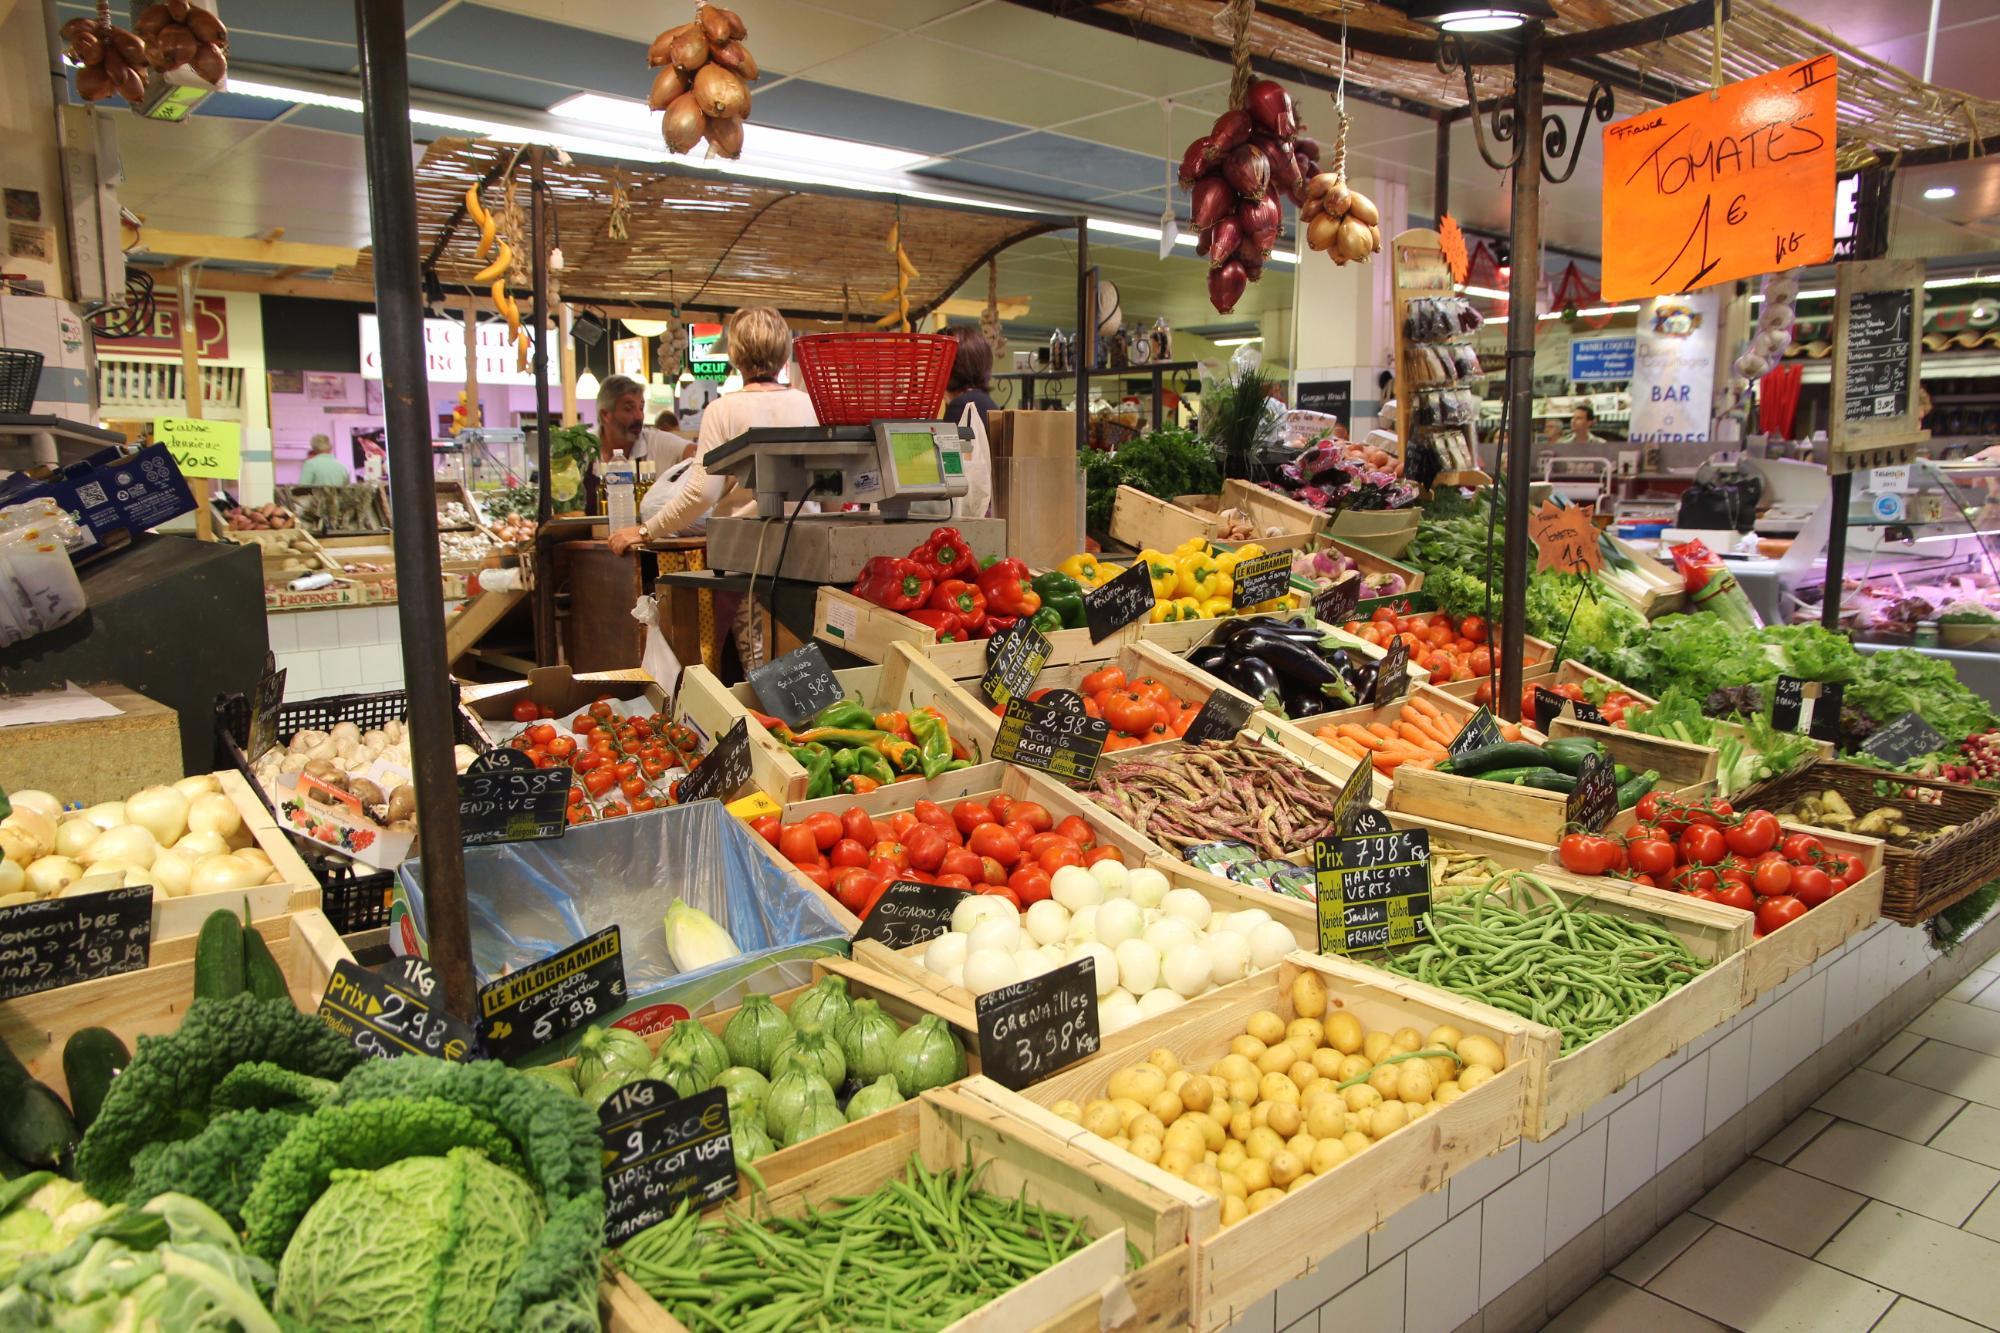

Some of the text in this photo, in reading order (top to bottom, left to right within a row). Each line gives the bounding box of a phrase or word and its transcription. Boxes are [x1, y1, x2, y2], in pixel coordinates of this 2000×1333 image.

[1626, 113, 1824, 194] TOMATES
[1651, 194, 1748, 292] 1 €
[1651, 385, 1690, 402] BAR
[279, 592, 338, 607] PROVENCE
[983, 673, 1001, 695] Prix
[1008, 700, 1032, 721] Prix
[1040, 710, 1087, 735] 2,98
[1019, 739, 1052, 756] ROMA
[475, 752, 510, 773] 1Kg
[1316, 841, 1344, 868] Prix
[1410, 845, 1430, 867] Kg
[1318, 882, 1343, 902] Produit
[1347, 882, 1392, 900] VERTS
[1320, 911, 1343, 929] Variété
[1388, 901, 1409, 918] Calibre
[1322, 934, 1345, 952] Origine
[1347, 927, 1389, 948] FRANCE
[403, 959, 437, 997] 1Kg
[487, 936, 616, 1012] LE KILOGRAMME
[328, 972, 367, 1010] Prix
[610, 1083, 655, 1114] 1Kg
